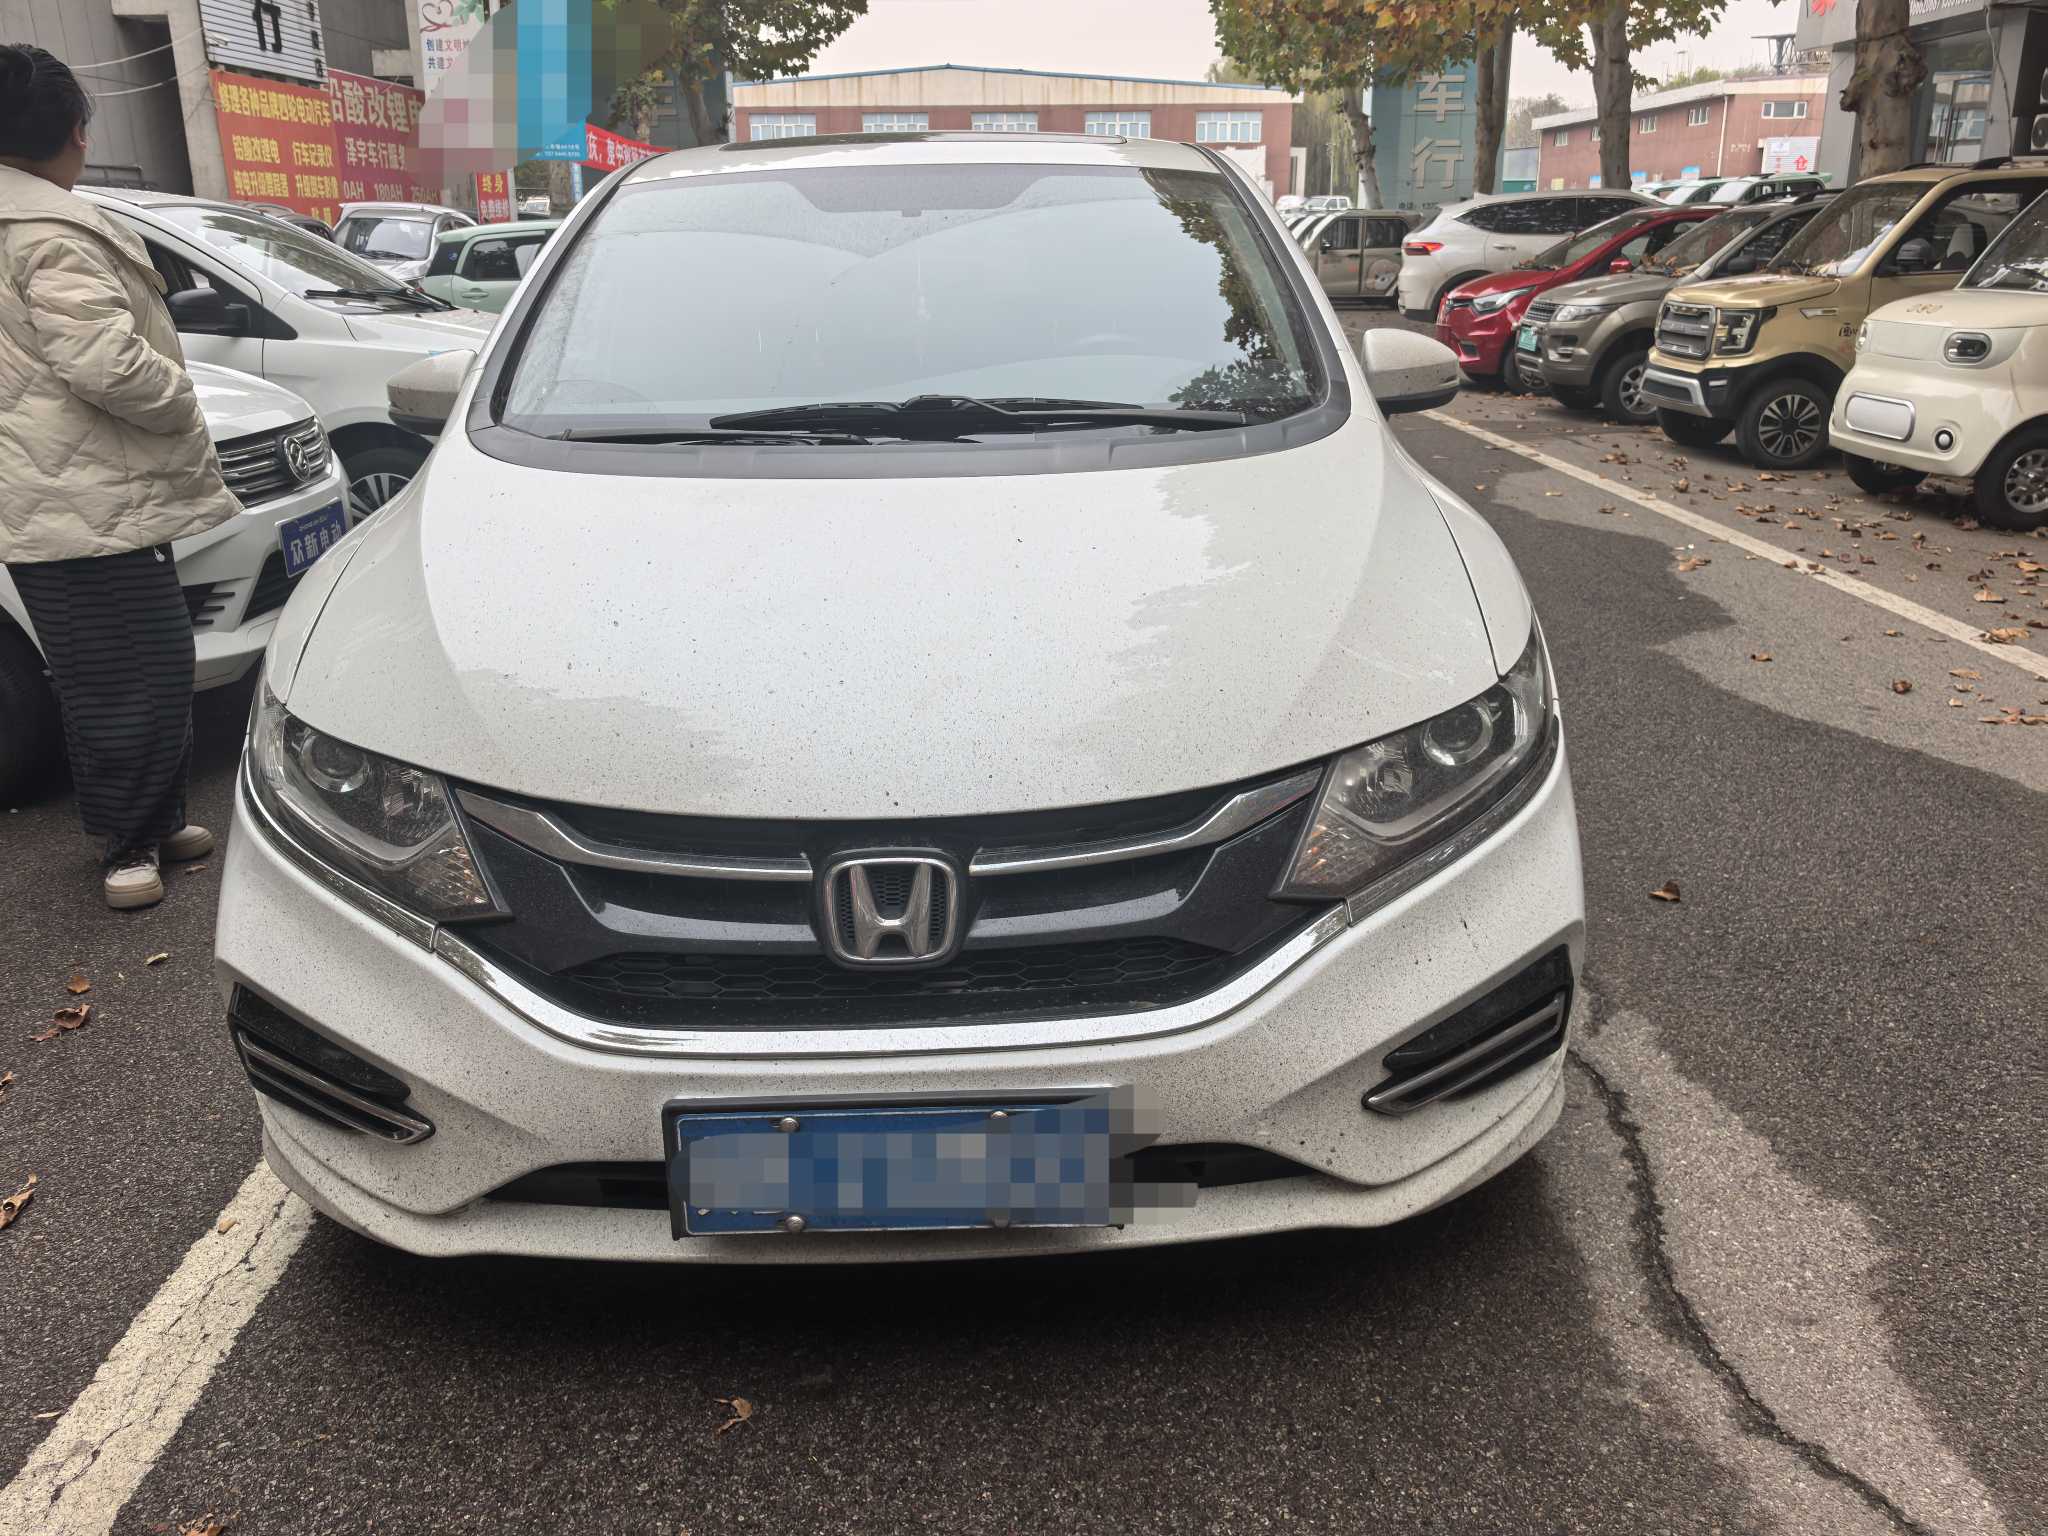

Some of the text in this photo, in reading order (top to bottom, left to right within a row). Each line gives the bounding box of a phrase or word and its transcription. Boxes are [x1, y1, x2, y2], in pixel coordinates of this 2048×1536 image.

[292, 142, 334, 168] 行车记录仪
